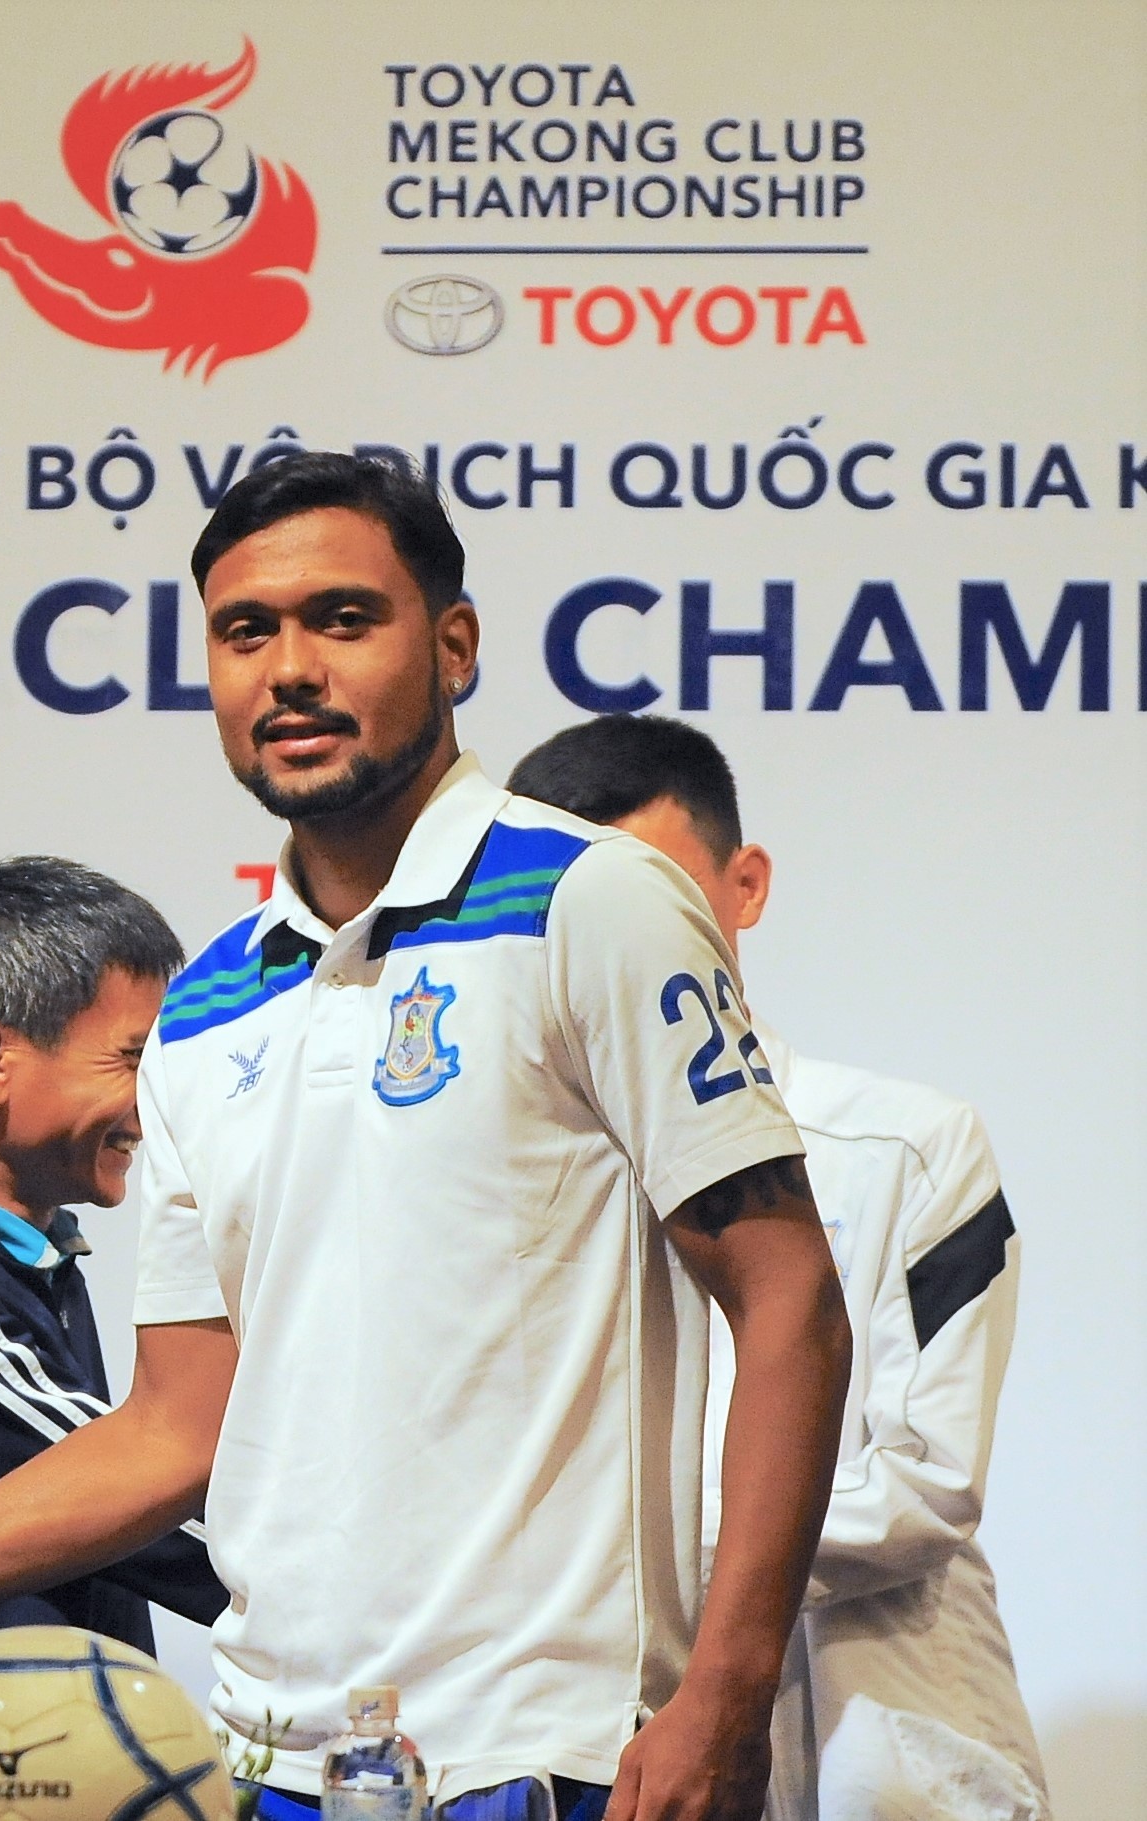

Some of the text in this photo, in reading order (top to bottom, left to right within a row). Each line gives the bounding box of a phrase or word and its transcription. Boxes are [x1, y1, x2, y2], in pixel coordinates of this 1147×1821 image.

[385, 64, 636, 109] TOYOTA
[388, 119, 867, 165] MEKONG CLUB
[386, 175, 867, 221] CHAMPIONSHIP
[523, 286, 867, 347] TOYOTA
[27, 426, 157, 533] BỘ
[609, 416, 898, 511] QUỐC
[925, 443, 1091, 511] GIA
